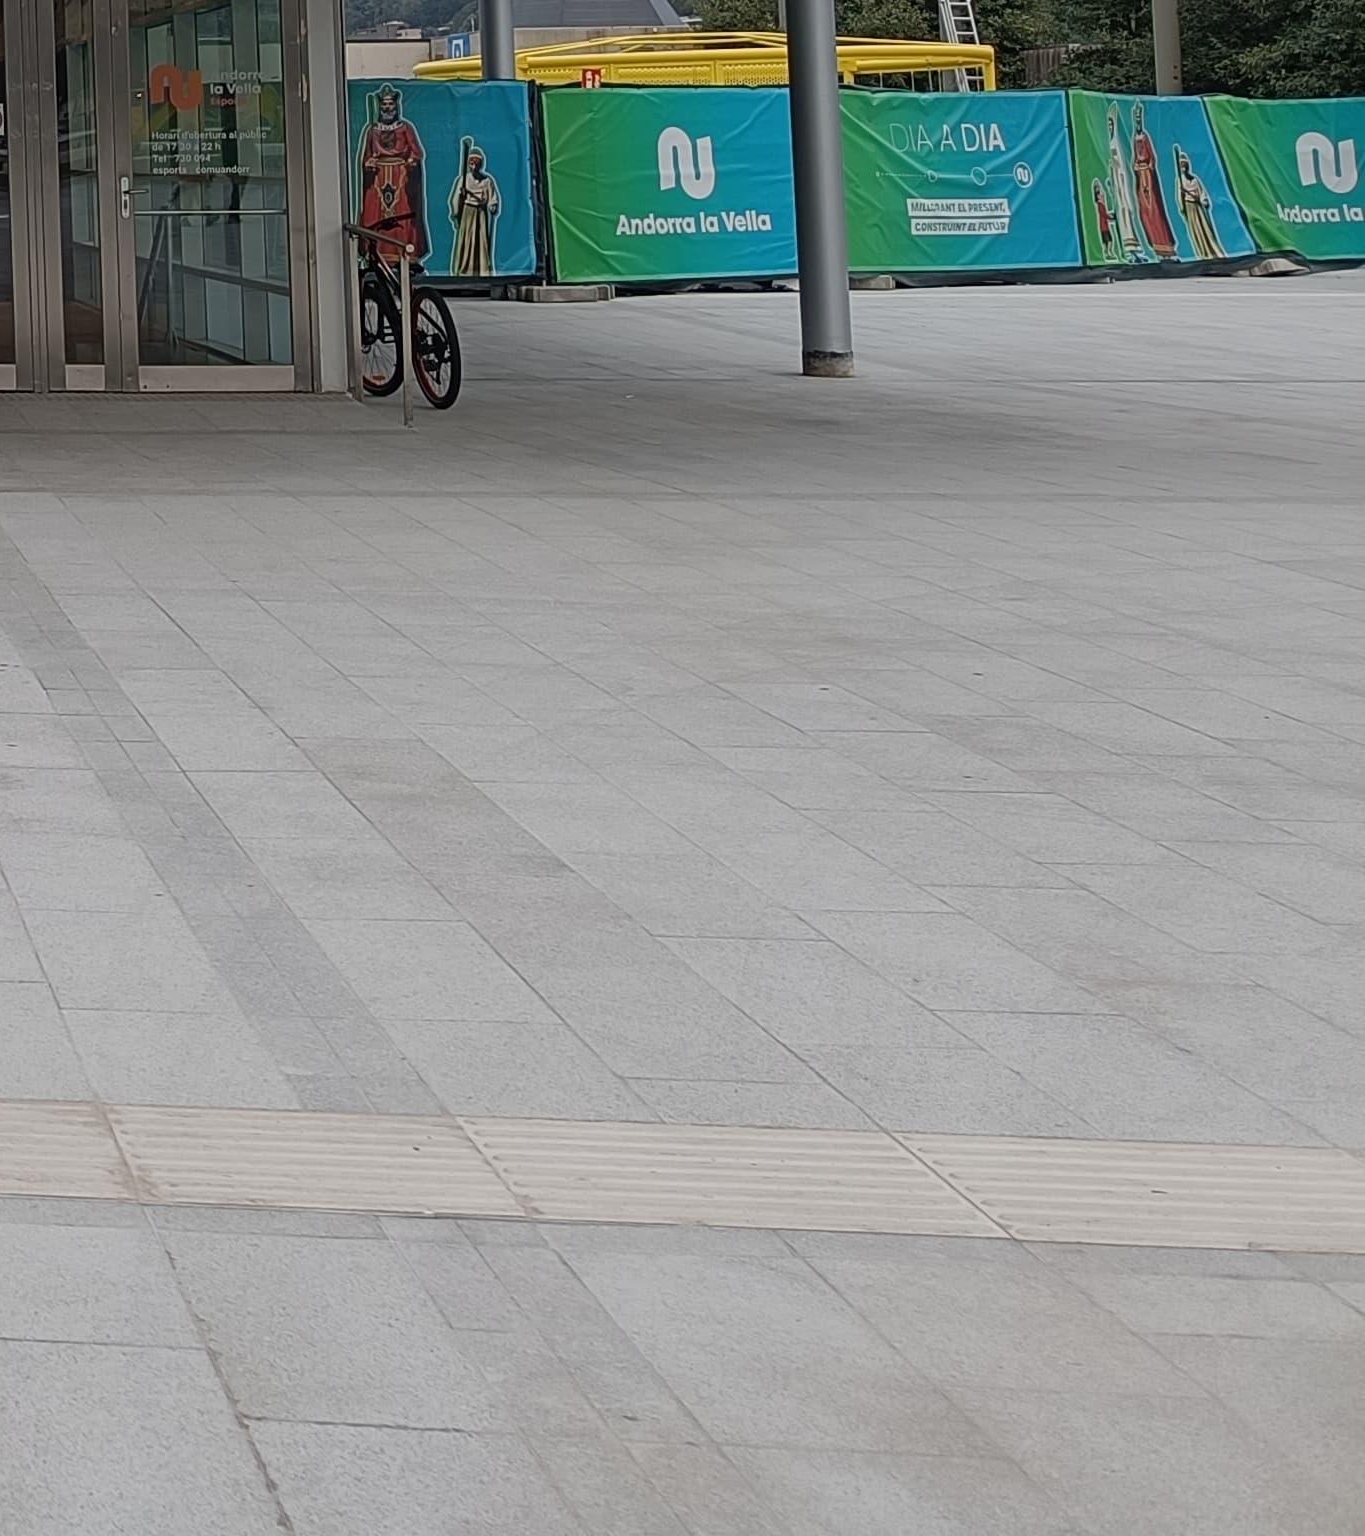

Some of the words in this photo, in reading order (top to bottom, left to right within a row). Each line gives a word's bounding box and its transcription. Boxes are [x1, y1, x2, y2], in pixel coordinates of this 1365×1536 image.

[210, 83, 224, 95] la
[889, 123, 934, 152] DIA
[940, 124, 957, 151] A
[961, 123, 1006, 152] DIA
[616, 213, 696, 236] Andorra
[699, 212, 719, 233] la
[720, 210, 772, 232] Vella
[1343, 203, 1365, 222] la
